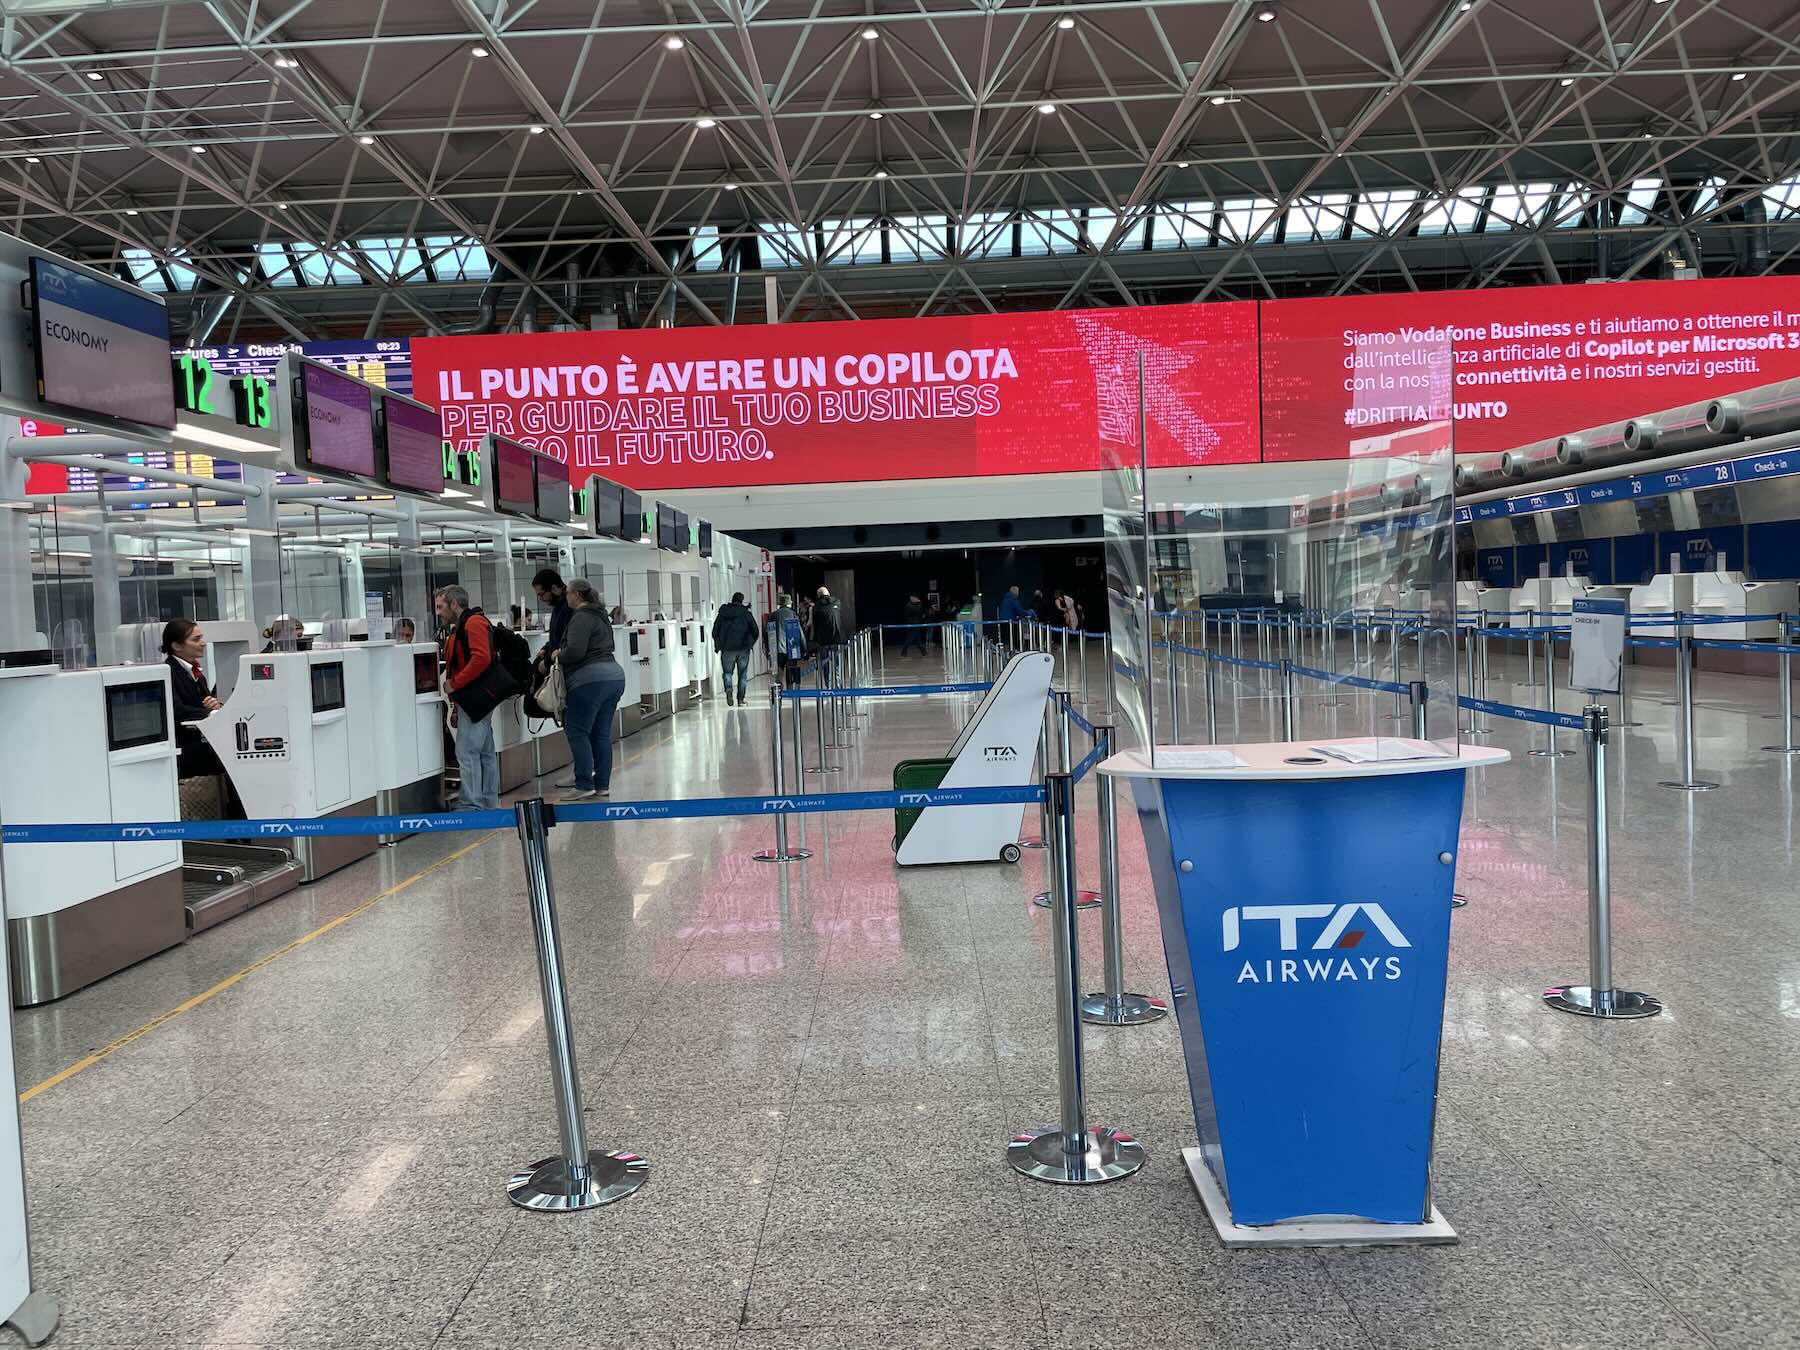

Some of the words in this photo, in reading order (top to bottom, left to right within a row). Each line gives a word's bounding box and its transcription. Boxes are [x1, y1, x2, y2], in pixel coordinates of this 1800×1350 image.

[45, 319, 109, 352] ECONOMY
[1343, 330, 1396, 347] Siamo
[1400, 325, 1486, 344] Vodafone
[1491, 321, 1571, 340] Business
[1575, 324, 1585, 335] e
[1590, 318, 1602, 335] ti
[1605, 315, 1679, 335] aiutiamo
[1684, 319, 1693, 331] a
[1697, 314, 1770, 330] ottenere
[1773, 311, 1784, 327] il
[376, 342, 401, 352] 09:23
[1343, 347, 1478, 369] dall'intellignza
[1482, 343, 1561, 364] artificiale
[1566, 342, 1581, 359] di
[1585, 339, 1655, 360] Copilot
[1658, 340, 1688, 358] per
[1693, 332, 1785, 353] Microsoft
[180, 353, 215, 414] 12
[439, 370, 473, 401] IL
[481, 365, 609, 400] PUNTO
[617, 354, 639, 394] È
[645, 359, 766, 393] AVERE
[774, 356, 827, 389] UN
[834, 348, 1019, 387] COPILOTA
[1344, 378, 1376, 391] con
[1380, 373, 1394, 389] la
[1400, 374, 1441, 388] nos
[1456, 363, 1567, 386] connettività
[1571, 369, 1581, 380] e
[1585, 364, 1590, 378] i
[1593, 362, 1642, 378] nostri
[1646, 359, 1700, 375] servizi
[1704, 356, 1760, 378] gestiti.
[243, 374, 272, 429] 13
[441, 403, 515, 438] PER
[519, 397, 685, 434] GUIDARE
[693, 395, 729, 429] IL
[732, 392, 812, 427] TUO
[818, 383, 1001, 424] BUSINESS
[576, 433, 611, 467] IL
[617, 428, 775, 466] FUTURO.
[467, 450, 481, 486] 15
[1715, 466, 1729, 480] 28
[1564, 492, 1574, 504] 30
[1631, 481, 1642, 494] 29
[984, 746, 1017, 756] ITA
[606, 807, 639, 816] ITA
[763, 800, 795, 809] ITA
[900, 794, 932, 804] ITA
[933, 793, 962, 801] AIRWAYS
[122, 828, 154, 837] ITA
[260, 824, 293, 834] ITA
[400, 819, 433, 829] ITA
[433, 818, 463, 826] AIRWAYS
[1222, 902, 1412, 952] ITA
[1237, 956, 1402, 983] AIRWAYS
